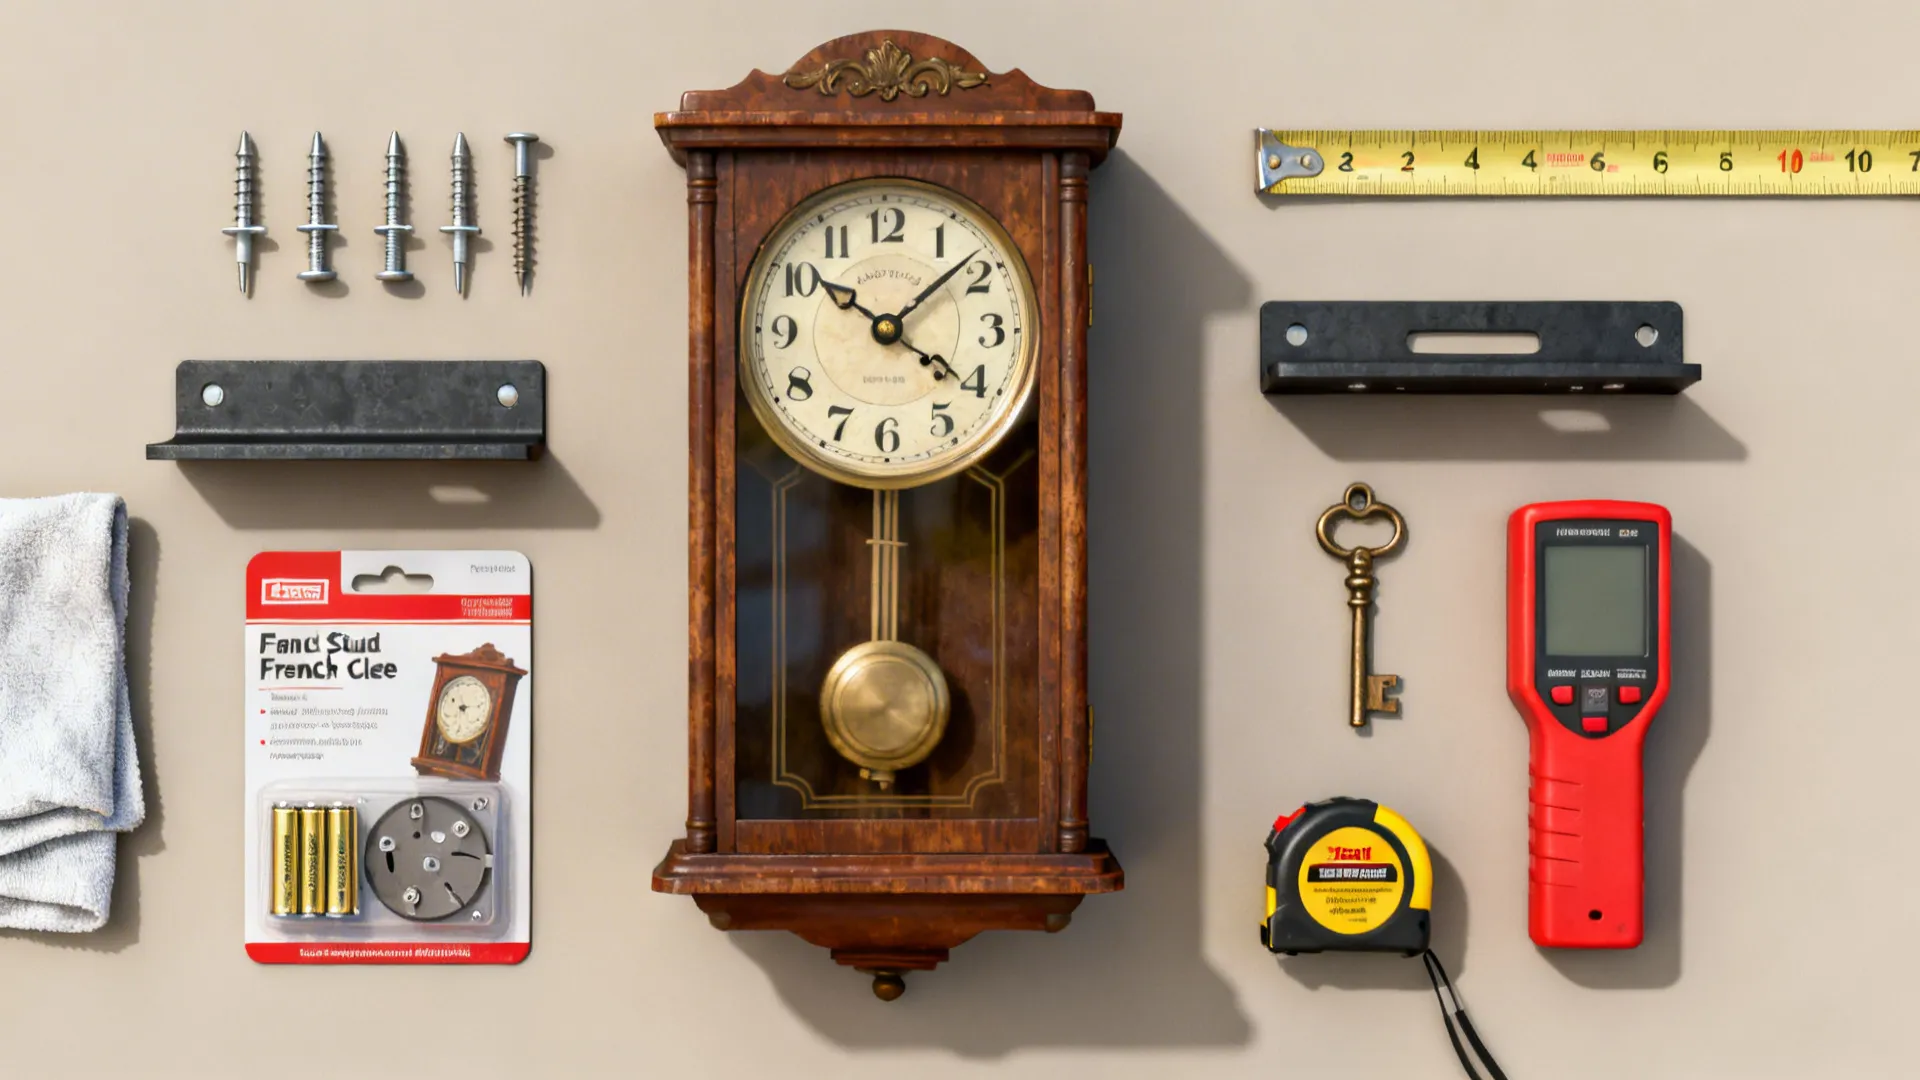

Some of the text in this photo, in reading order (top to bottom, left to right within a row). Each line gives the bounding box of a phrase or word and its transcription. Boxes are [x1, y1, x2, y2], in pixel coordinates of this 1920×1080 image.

[1401, 151, 1415, 171] 2
[1464, 147, 1480, 170] 4
[1521, 150, 1538, 170] 4
[1590, 152, 1606, 172] 6
[1653, 151, 1668, 174] 6
[1777, 149, 1803, 174] 10
[1845, 149, 1873, 172] 10
[824, 225, 849, 259] 11
[867, 207, 906, 244] 12
[934, 222, 945, 259] 1
[785, 261, 820, 298] 10
[965, 260, 992, 296] 2
[771, 314, 798, 350] 9
[978, 313, 1006, 349] 3
[786, 366, 814, 402] 8
[960, 364, 989, 399] 4
[827, 404, 856, 442] 7
[874, 416, 901, 453] 6
[929, 401, 955, 438] 5
